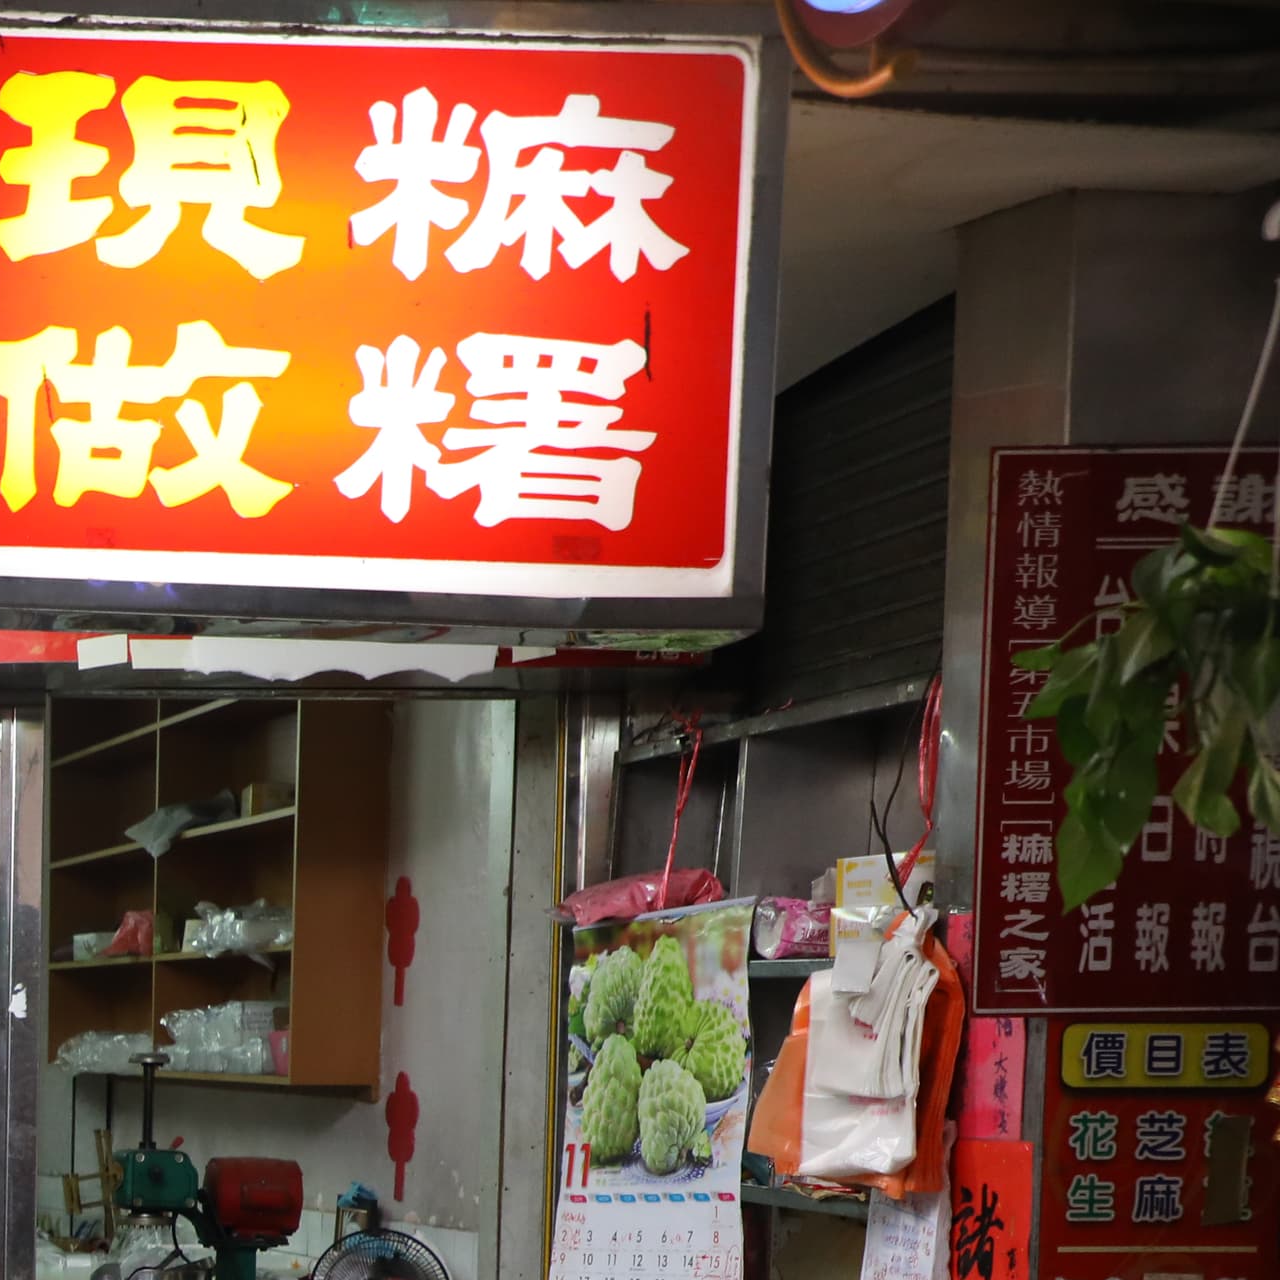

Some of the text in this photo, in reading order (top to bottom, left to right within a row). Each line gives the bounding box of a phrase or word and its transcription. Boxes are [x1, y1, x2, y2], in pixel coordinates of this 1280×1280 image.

[1081, 1031, 1249, 1079] 價目表
[565, 1143, 592, 1188] 11
[1066, 1111, 1117, 1222] 花生
[1133, 1111, 1186, 1222] 芝麻
[561, 1230, 720, 1244] 2 3 4 5 6 7 8
[559, 1253, 720, 1269] 9 10 11 12 13 14 15
